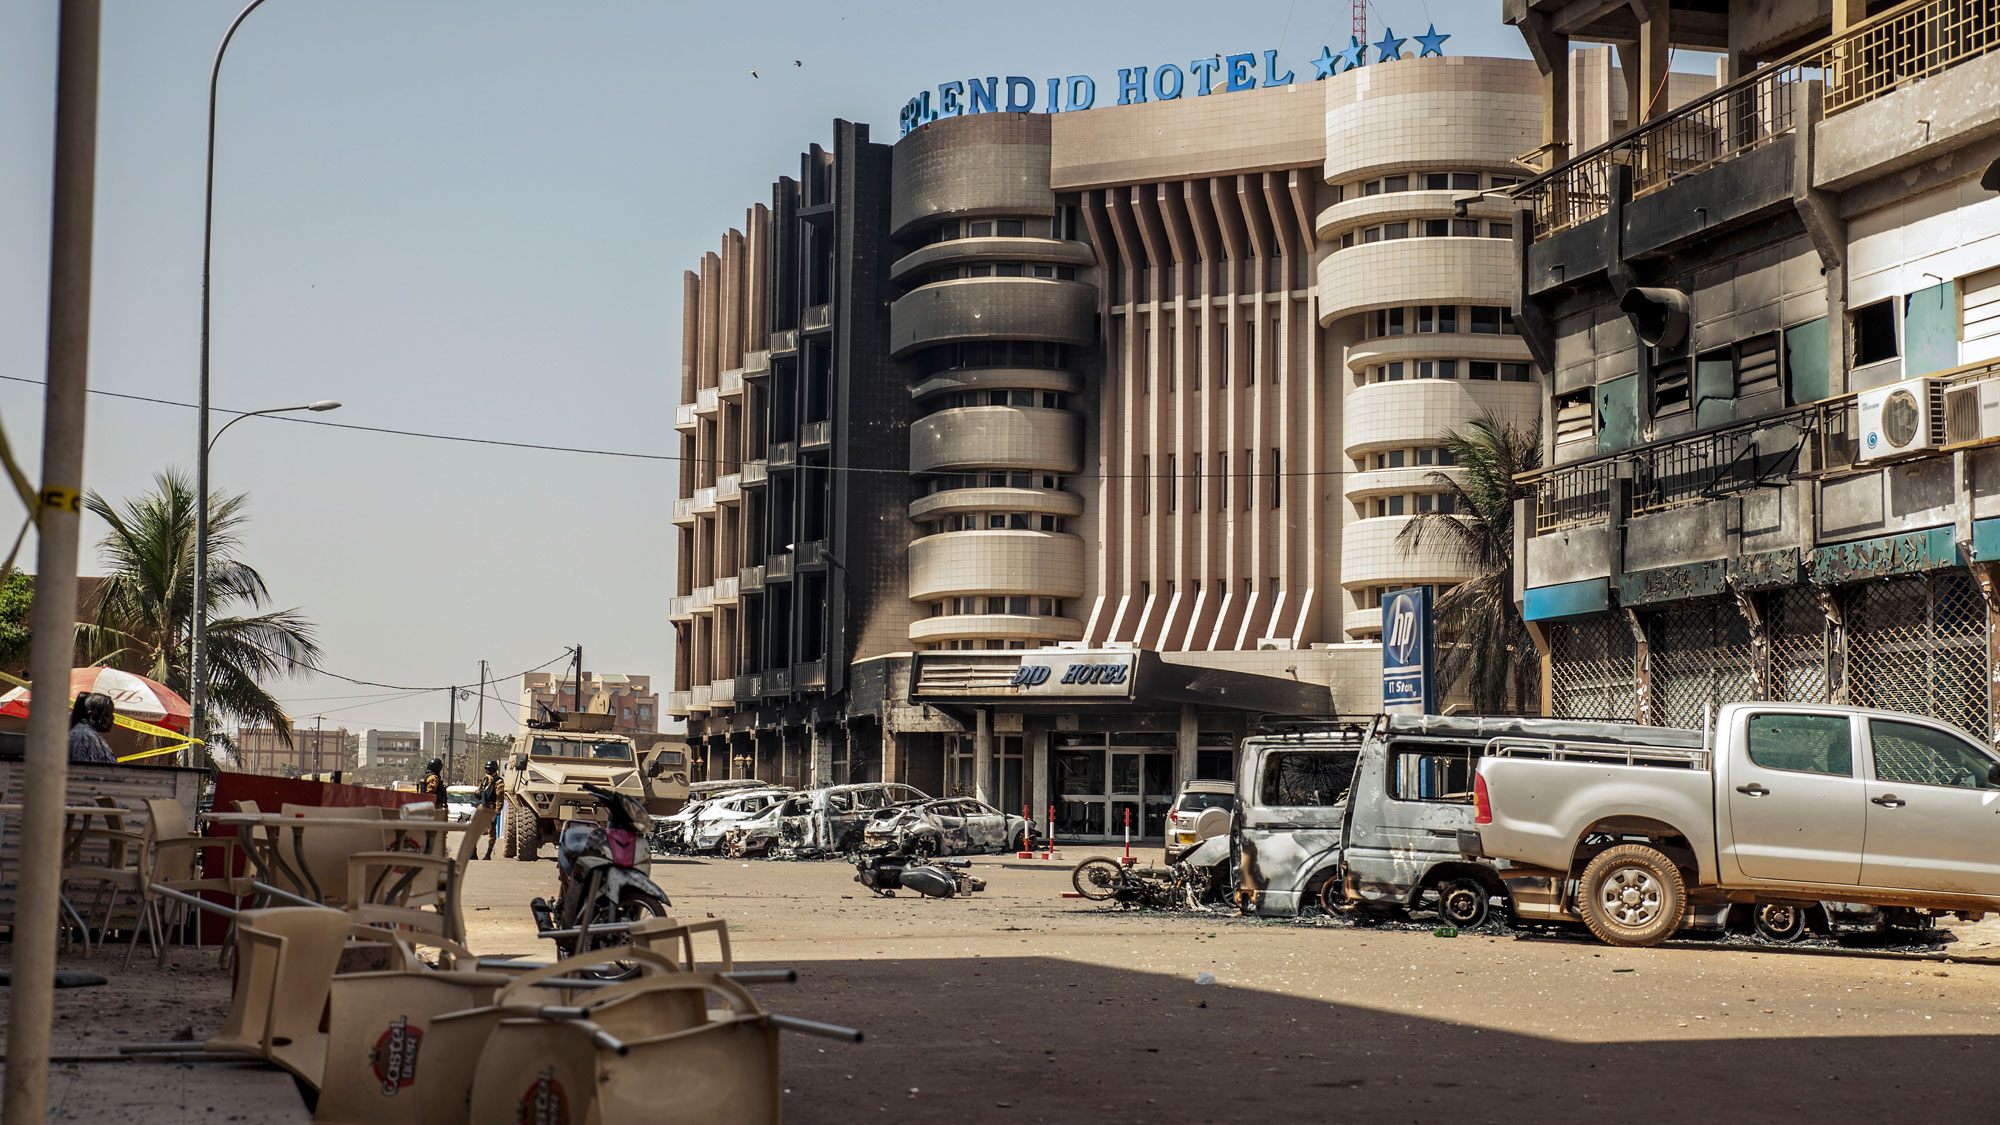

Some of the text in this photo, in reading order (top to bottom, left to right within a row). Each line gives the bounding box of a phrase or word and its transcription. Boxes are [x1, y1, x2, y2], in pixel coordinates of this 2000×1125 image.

[900, 50, 1295, 137] SPLENDID HOTEL
[1390, 595, 1414, 664] hp
[1011, 665, 1128, 685] DID HOTEL
